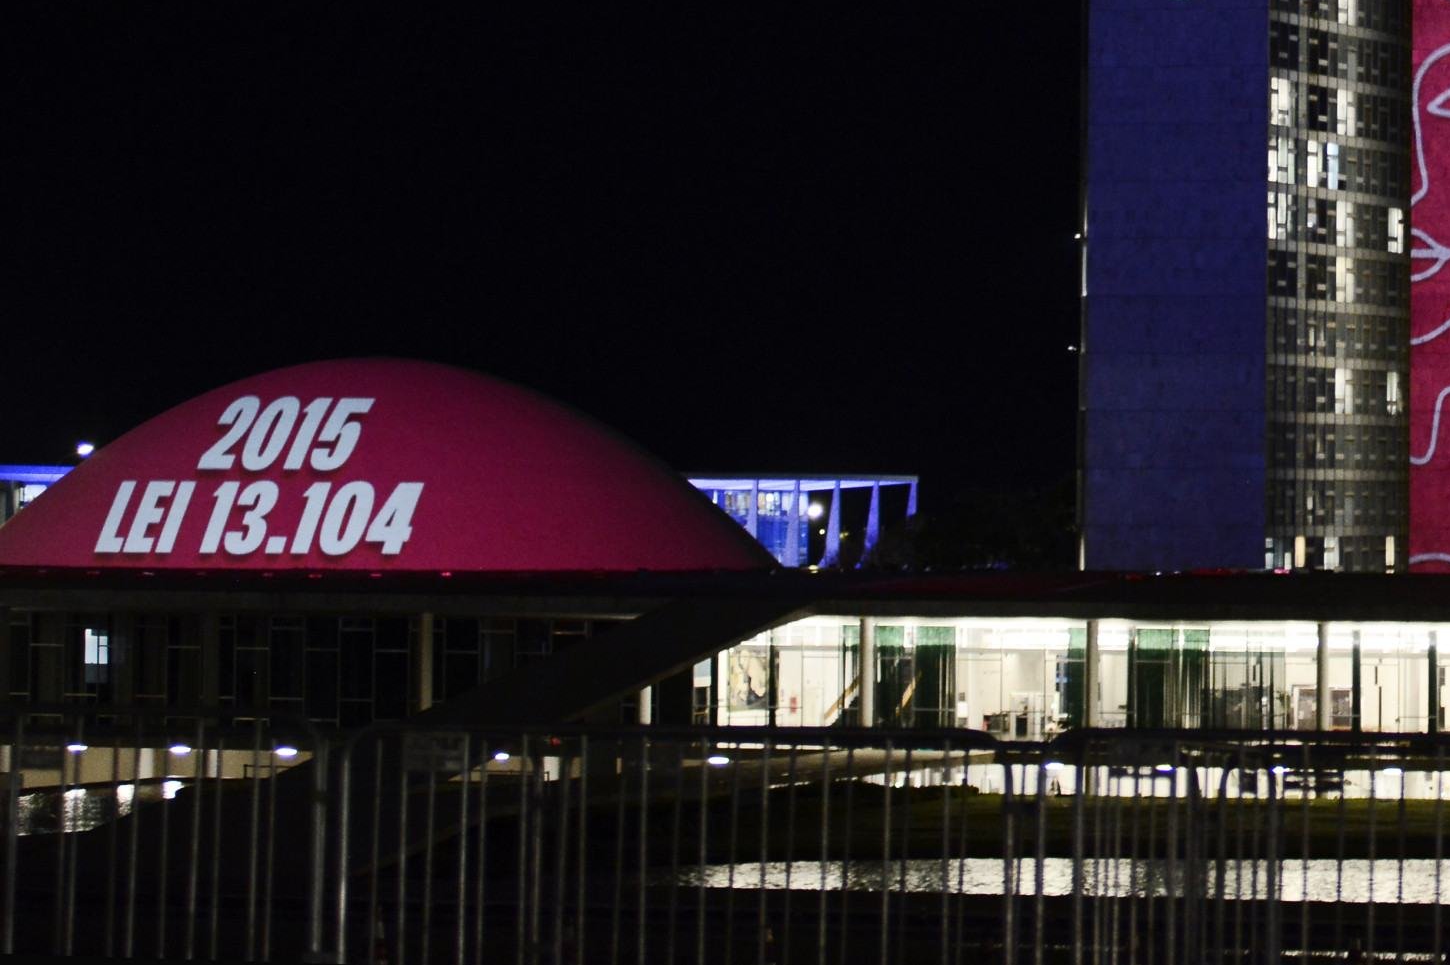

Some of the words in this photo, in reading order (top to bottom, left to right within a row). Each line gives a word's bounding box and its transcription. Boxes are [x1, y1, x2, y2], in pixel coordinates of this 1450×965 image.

[197, 396, 375, 471] 2015
[94, 480, 196, 554] LEI
[200, 480, 425, 556] 13.104
